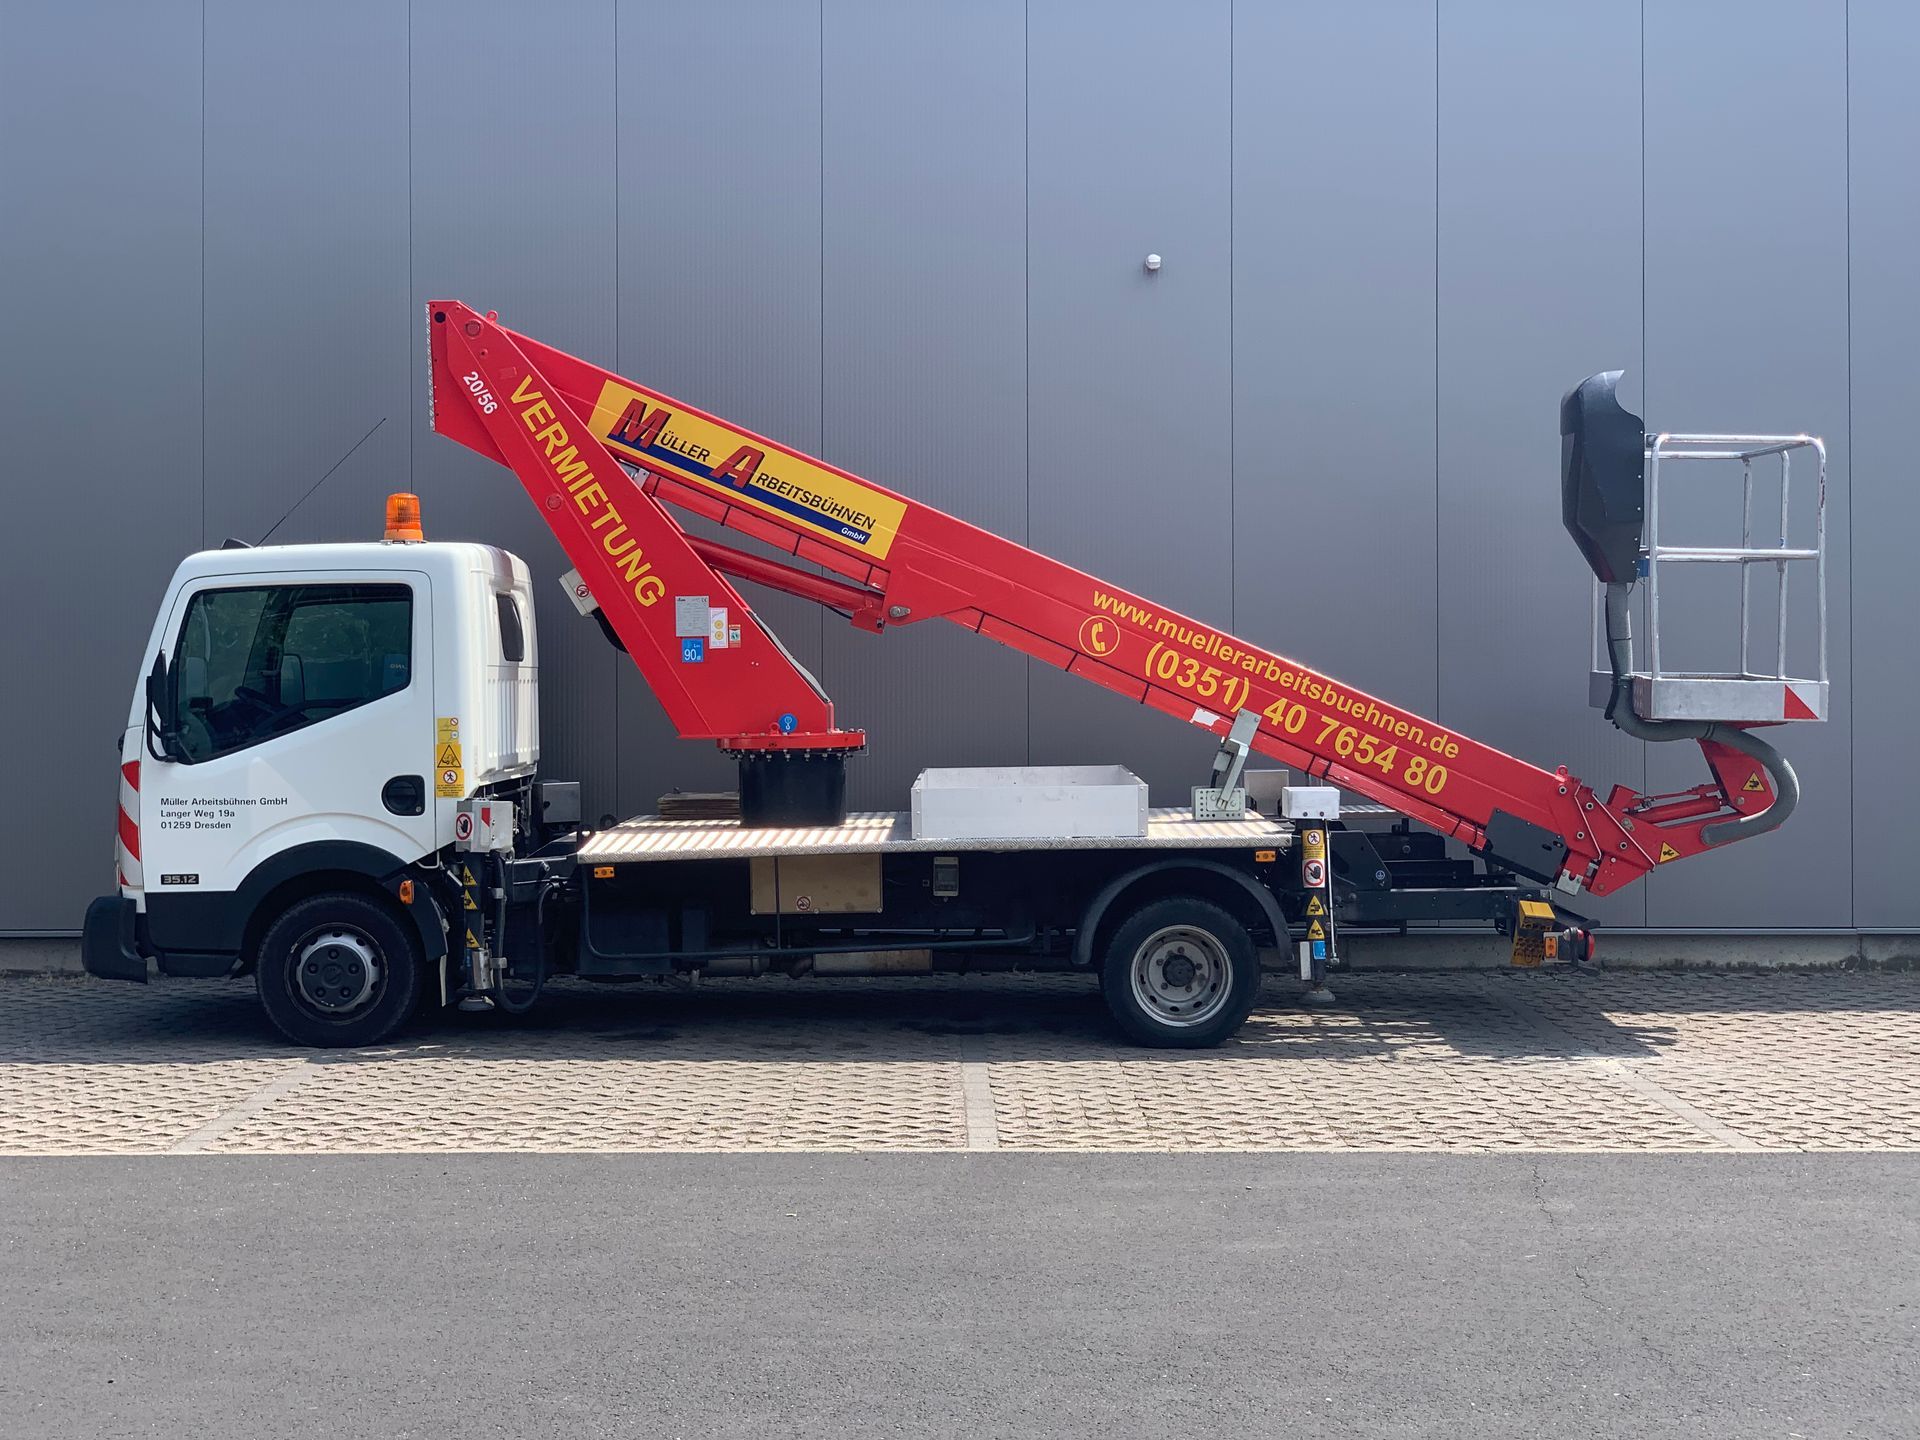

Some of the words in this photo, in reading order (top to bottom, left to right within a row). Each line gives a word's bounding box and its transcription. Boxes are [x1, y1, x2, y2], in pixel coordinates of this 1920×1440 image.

[463, 371, 498, 415] 20/56
[608, 397, 711, 463] MÜLLER
[709, 445, 877, 530] ARBEITSBÜHNEN
[510, 374, 665, 607] VERMIETUNG
[841, 526, 866, 541] GmbH
[684, 649, 697, 660] 90
[1093, 590, 1460, 759] www.muellerarbeitsbuehnen.de
[1144, 642, 1250, 713] (0351)
[1263, 698, 1307, 735] 40
[1314, 715, 1400, 773] 7654
[1403, 757, 1447, 794] 80
[160, 797, 188, 806] Müller
[191, 797, 257, 806] Arbeitsbühnen
[259, 797, 288, 805] GmbH
[160, 809, 191, 819] Langer
[194, 809, 215, 819] Weg
[219, 809, 235, 817] 19a
[160, 821, 192, 829] 01259
[194, 821, 232, 829] Dresden
[163, 875, 197, 884] 35.12
